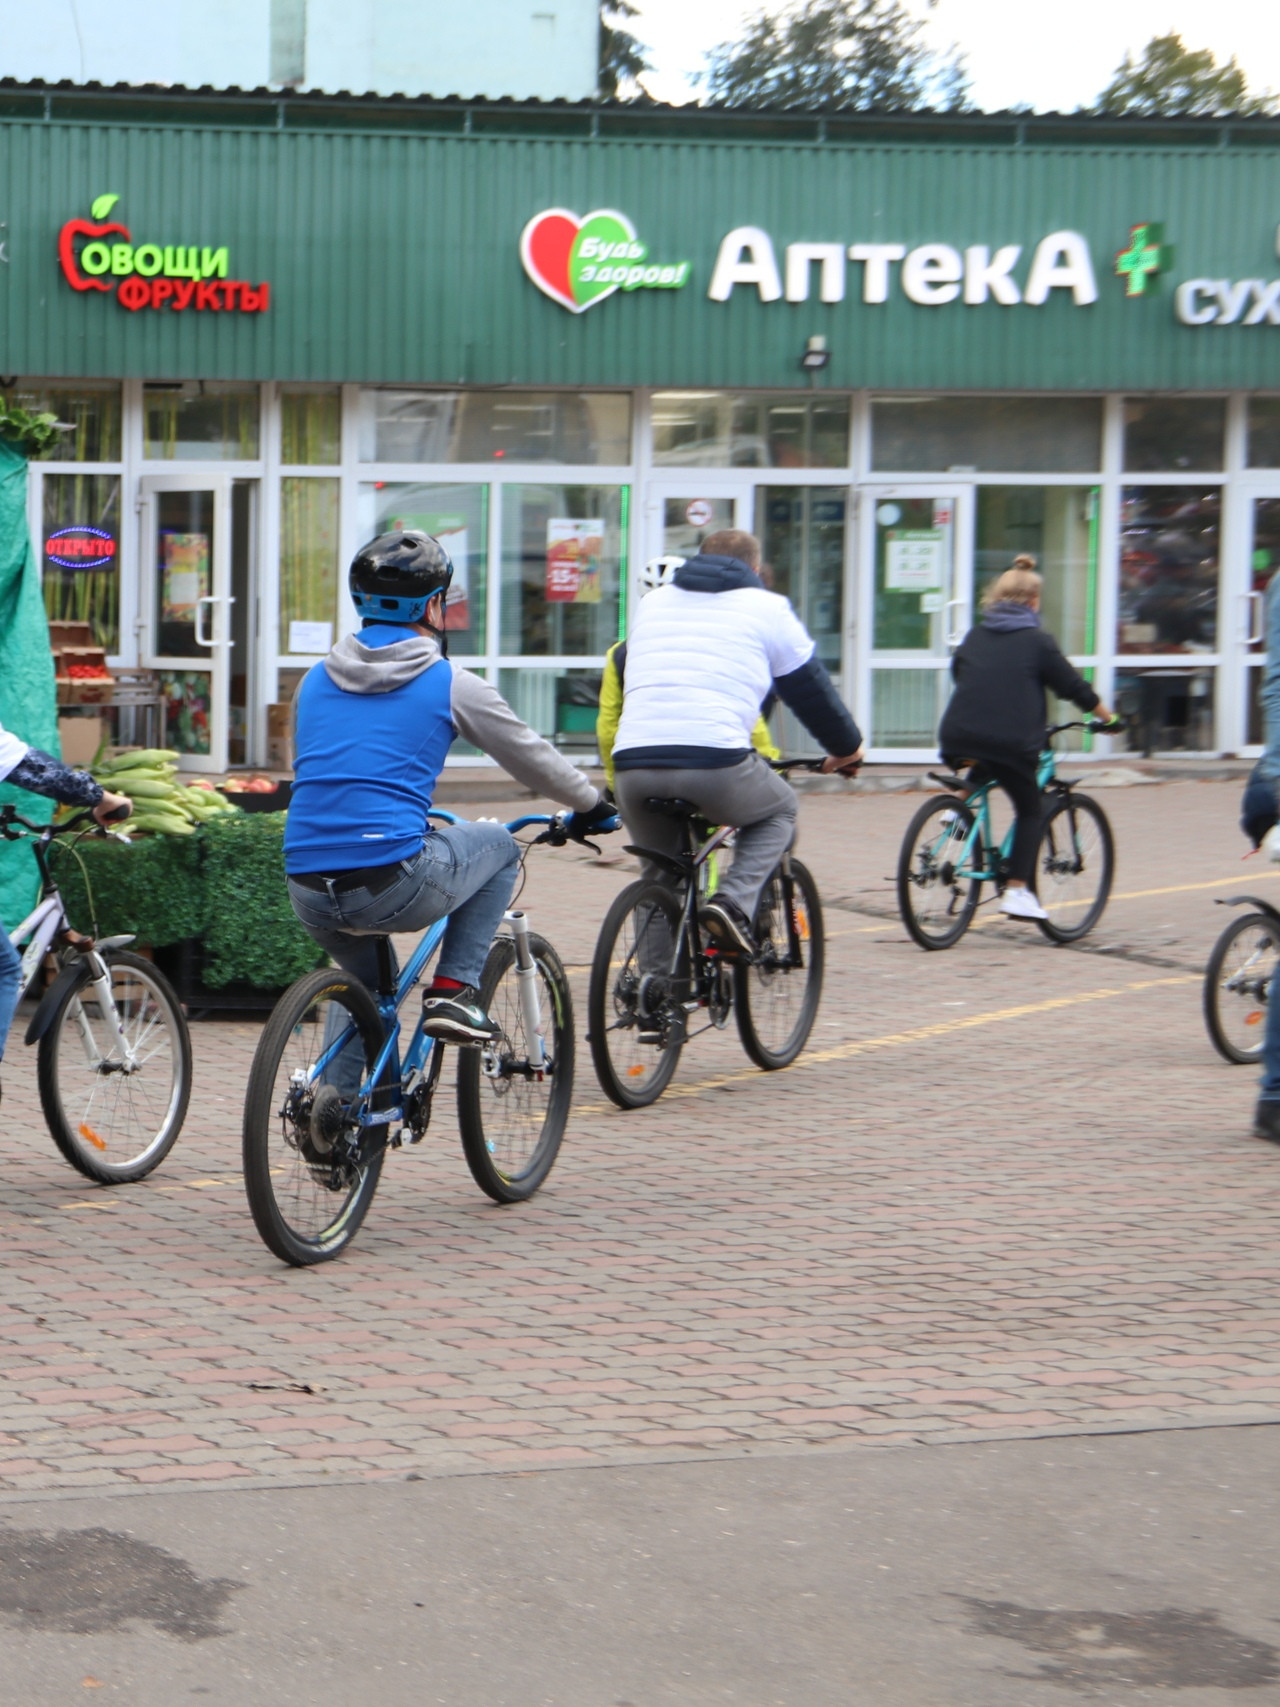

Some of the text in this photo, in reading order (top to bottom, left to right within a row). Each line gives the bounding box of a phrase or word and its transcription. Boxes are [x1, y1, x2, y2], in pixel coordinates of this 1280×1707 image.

[577, 236, 646, 262] Будь
[118, 276, 269, 312] ФРУКТЫ
[45, 538, 116, 556] ОТКРЫТО
